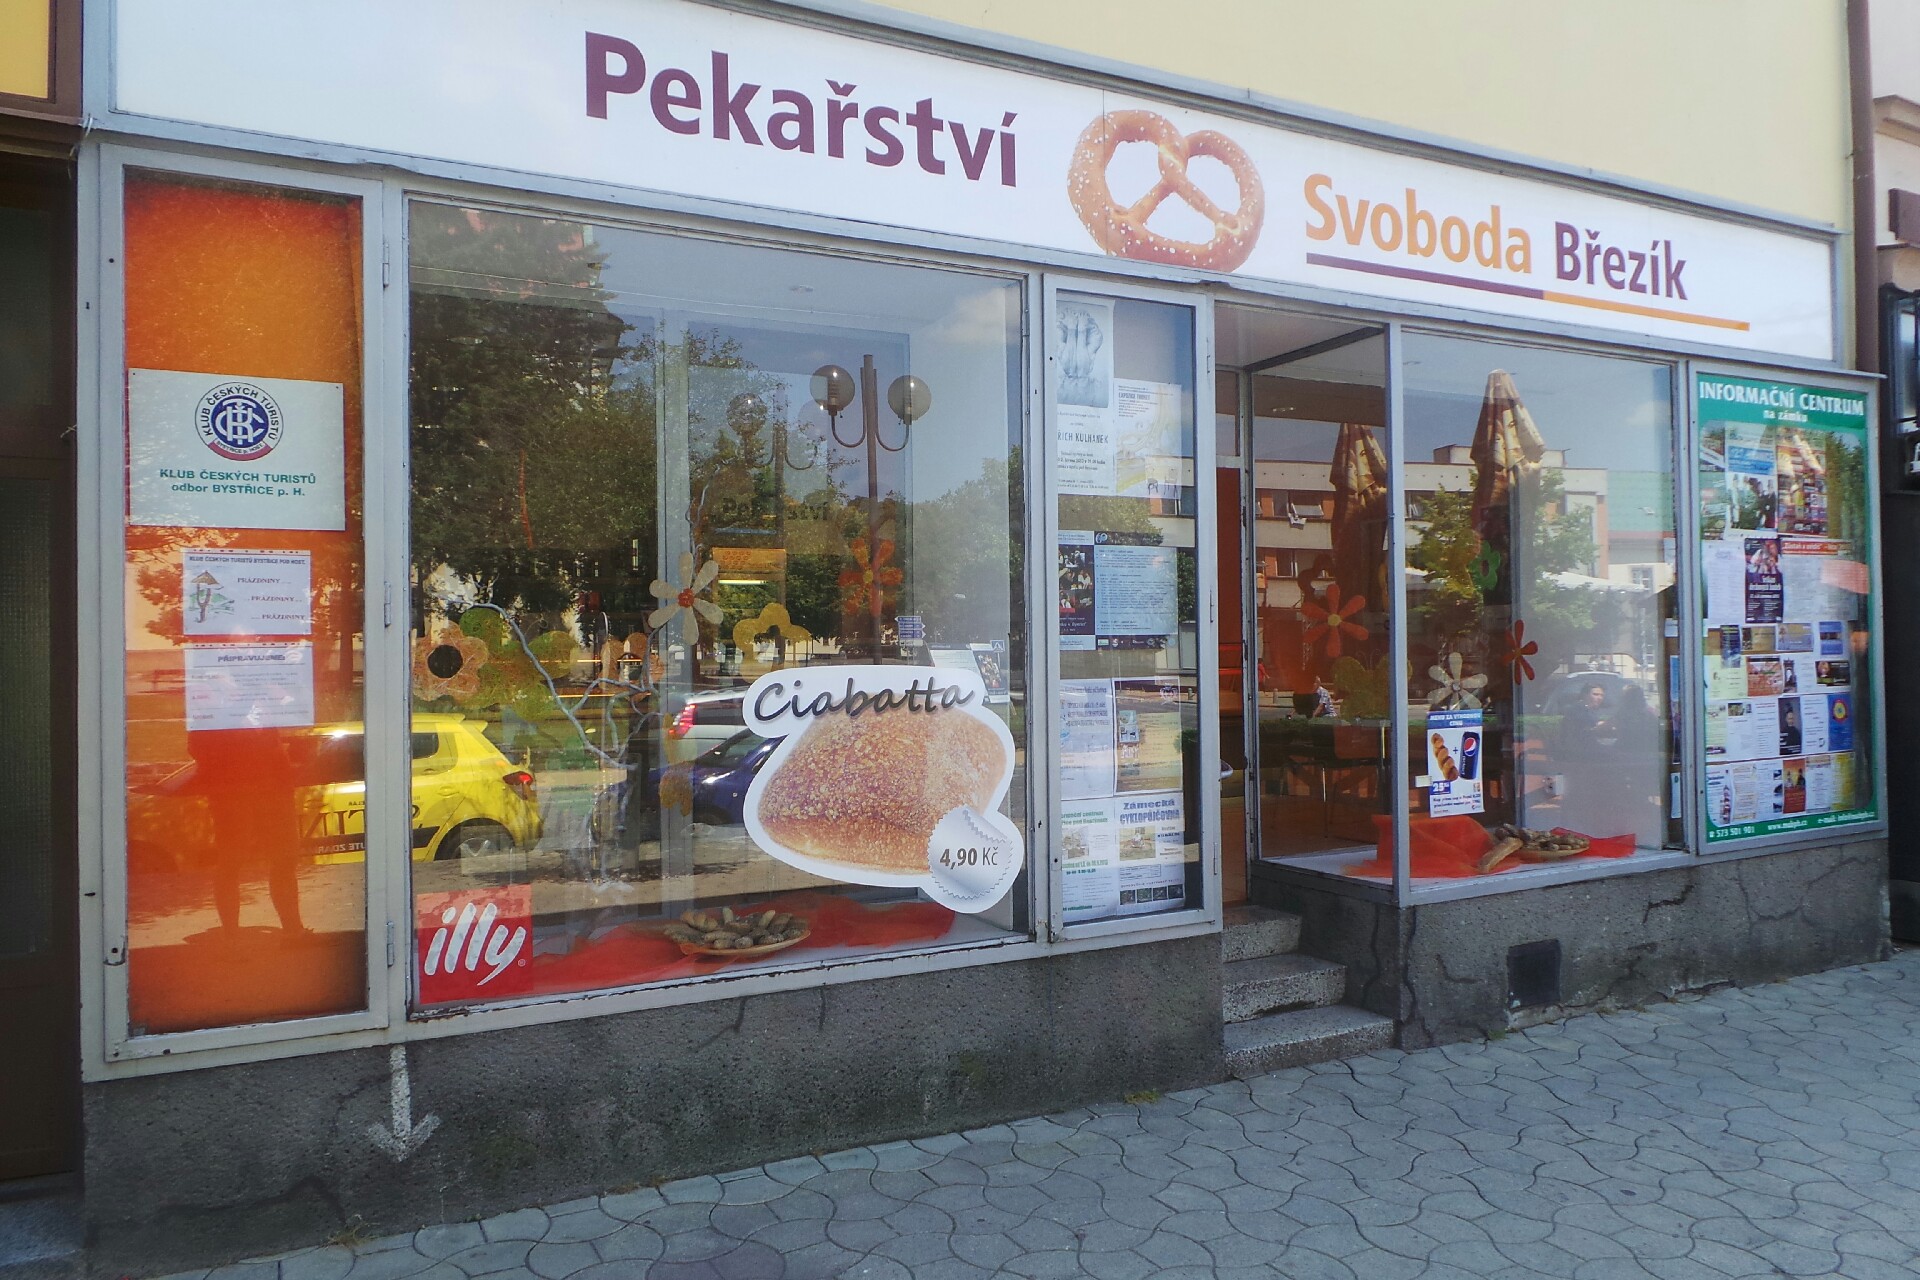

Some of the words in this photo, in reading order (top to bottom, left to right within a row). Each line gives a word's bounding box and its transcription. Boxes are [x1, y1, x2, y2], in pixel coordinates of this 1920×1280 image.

[585, 30, 1018, 188] Pekařství
[1303, 172, 1532, 274] Svoboda
[1554, 221, 1688, 301] Březík
[205, 384, 259, 406] ČESKÝCH
[1699, 381, 1795, 409] INFORMAČNÍ
[1799, 393, 1864, 416] CENTRUM
[200, 407, 213, 437] KLUB
[260, 396, 280, 441] TURISTŮ
[1763, 409, 1776, 419] na
[159, 468, 195, 479] KLUB
[199, 469, 260, 482] ČESKÝCH
[264, 472, 316, 484] TURISTŮ
[171, 482, 208, 492] odbor
[212, 483, 274, 495] BYSTŘICE
[277, 488, 289, 497] p.
[293, 487, 305, 496] H.
[753, 676, 974, 722] Ciabatta
[1715, 827, 1729, 838] 573
[938, 847, 978, 870] 4,90
[981, 847, 999, 867] Kč
[424, 902, 527, 986] illy
